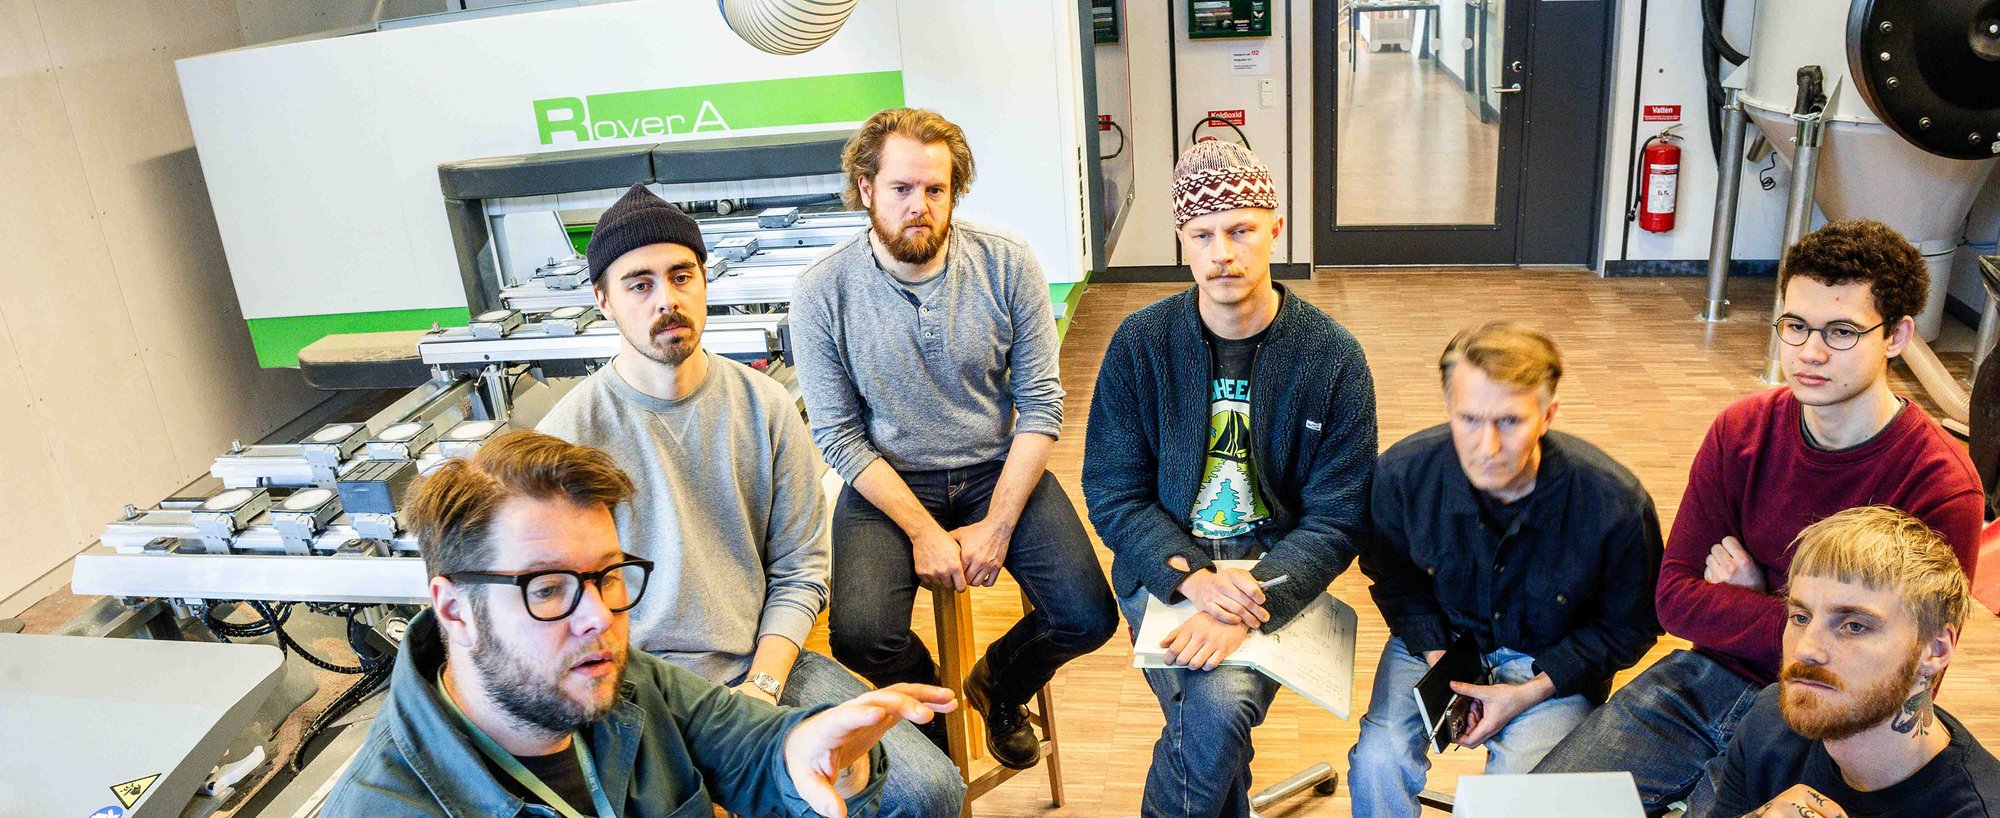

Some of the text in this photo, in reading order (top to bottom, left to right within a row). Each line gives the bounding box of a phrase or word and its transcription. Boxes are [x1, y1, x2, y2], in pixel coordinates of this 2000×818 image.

[532, 96, 730, 145] Rover A
[1652, 106, 1673, 114] Vatten
[1212, 378, 1250, 401] HEE
